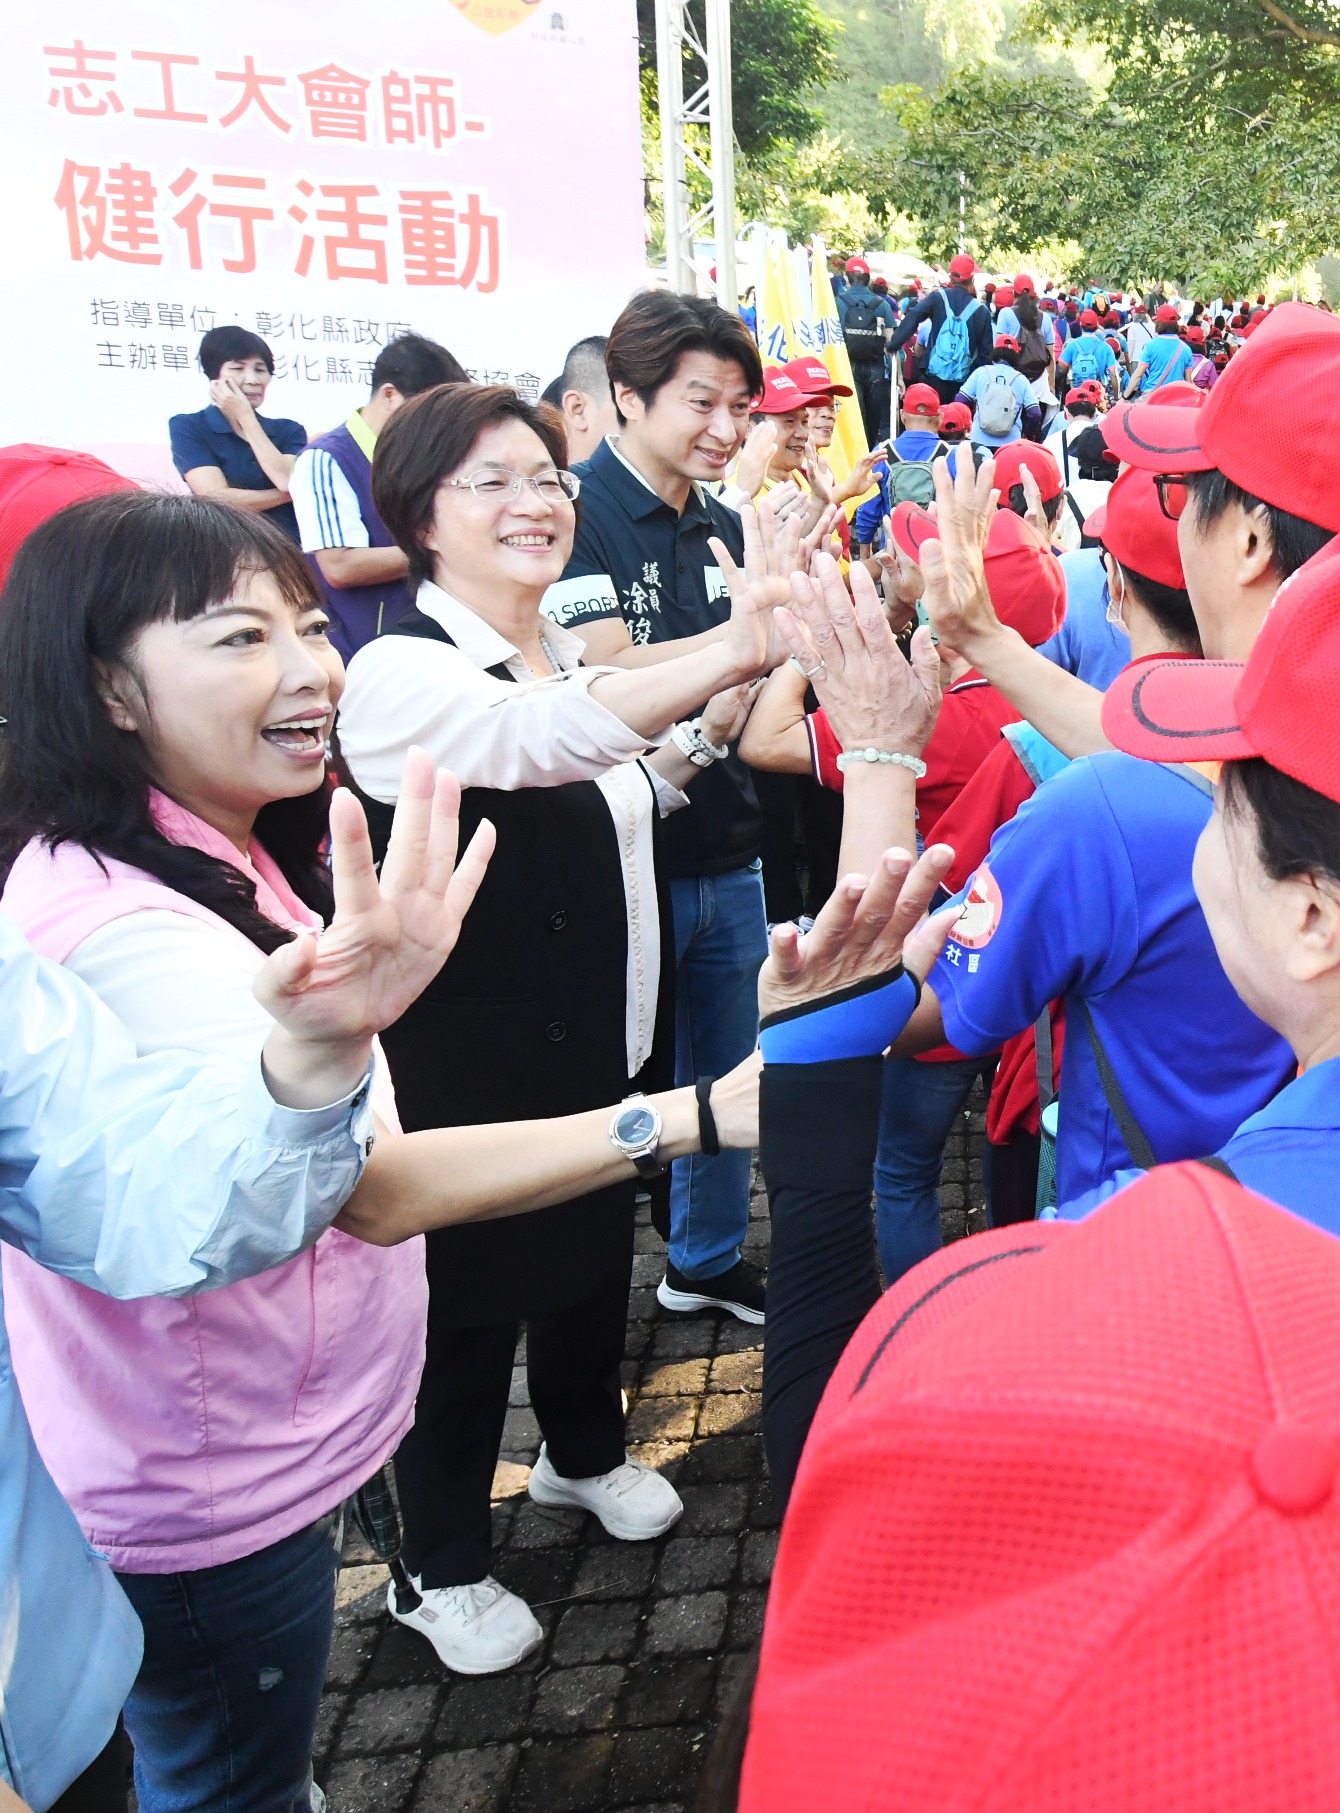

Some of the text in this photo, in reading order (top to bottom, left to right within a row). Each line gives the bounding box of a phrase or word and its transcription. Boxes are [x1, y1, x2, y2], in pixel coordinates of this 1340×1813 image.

[43, 39, 485, 149] 志工大會師-
[54, 158, 500, 294] 健行活動
[642, 561, 662, 614] 議員
